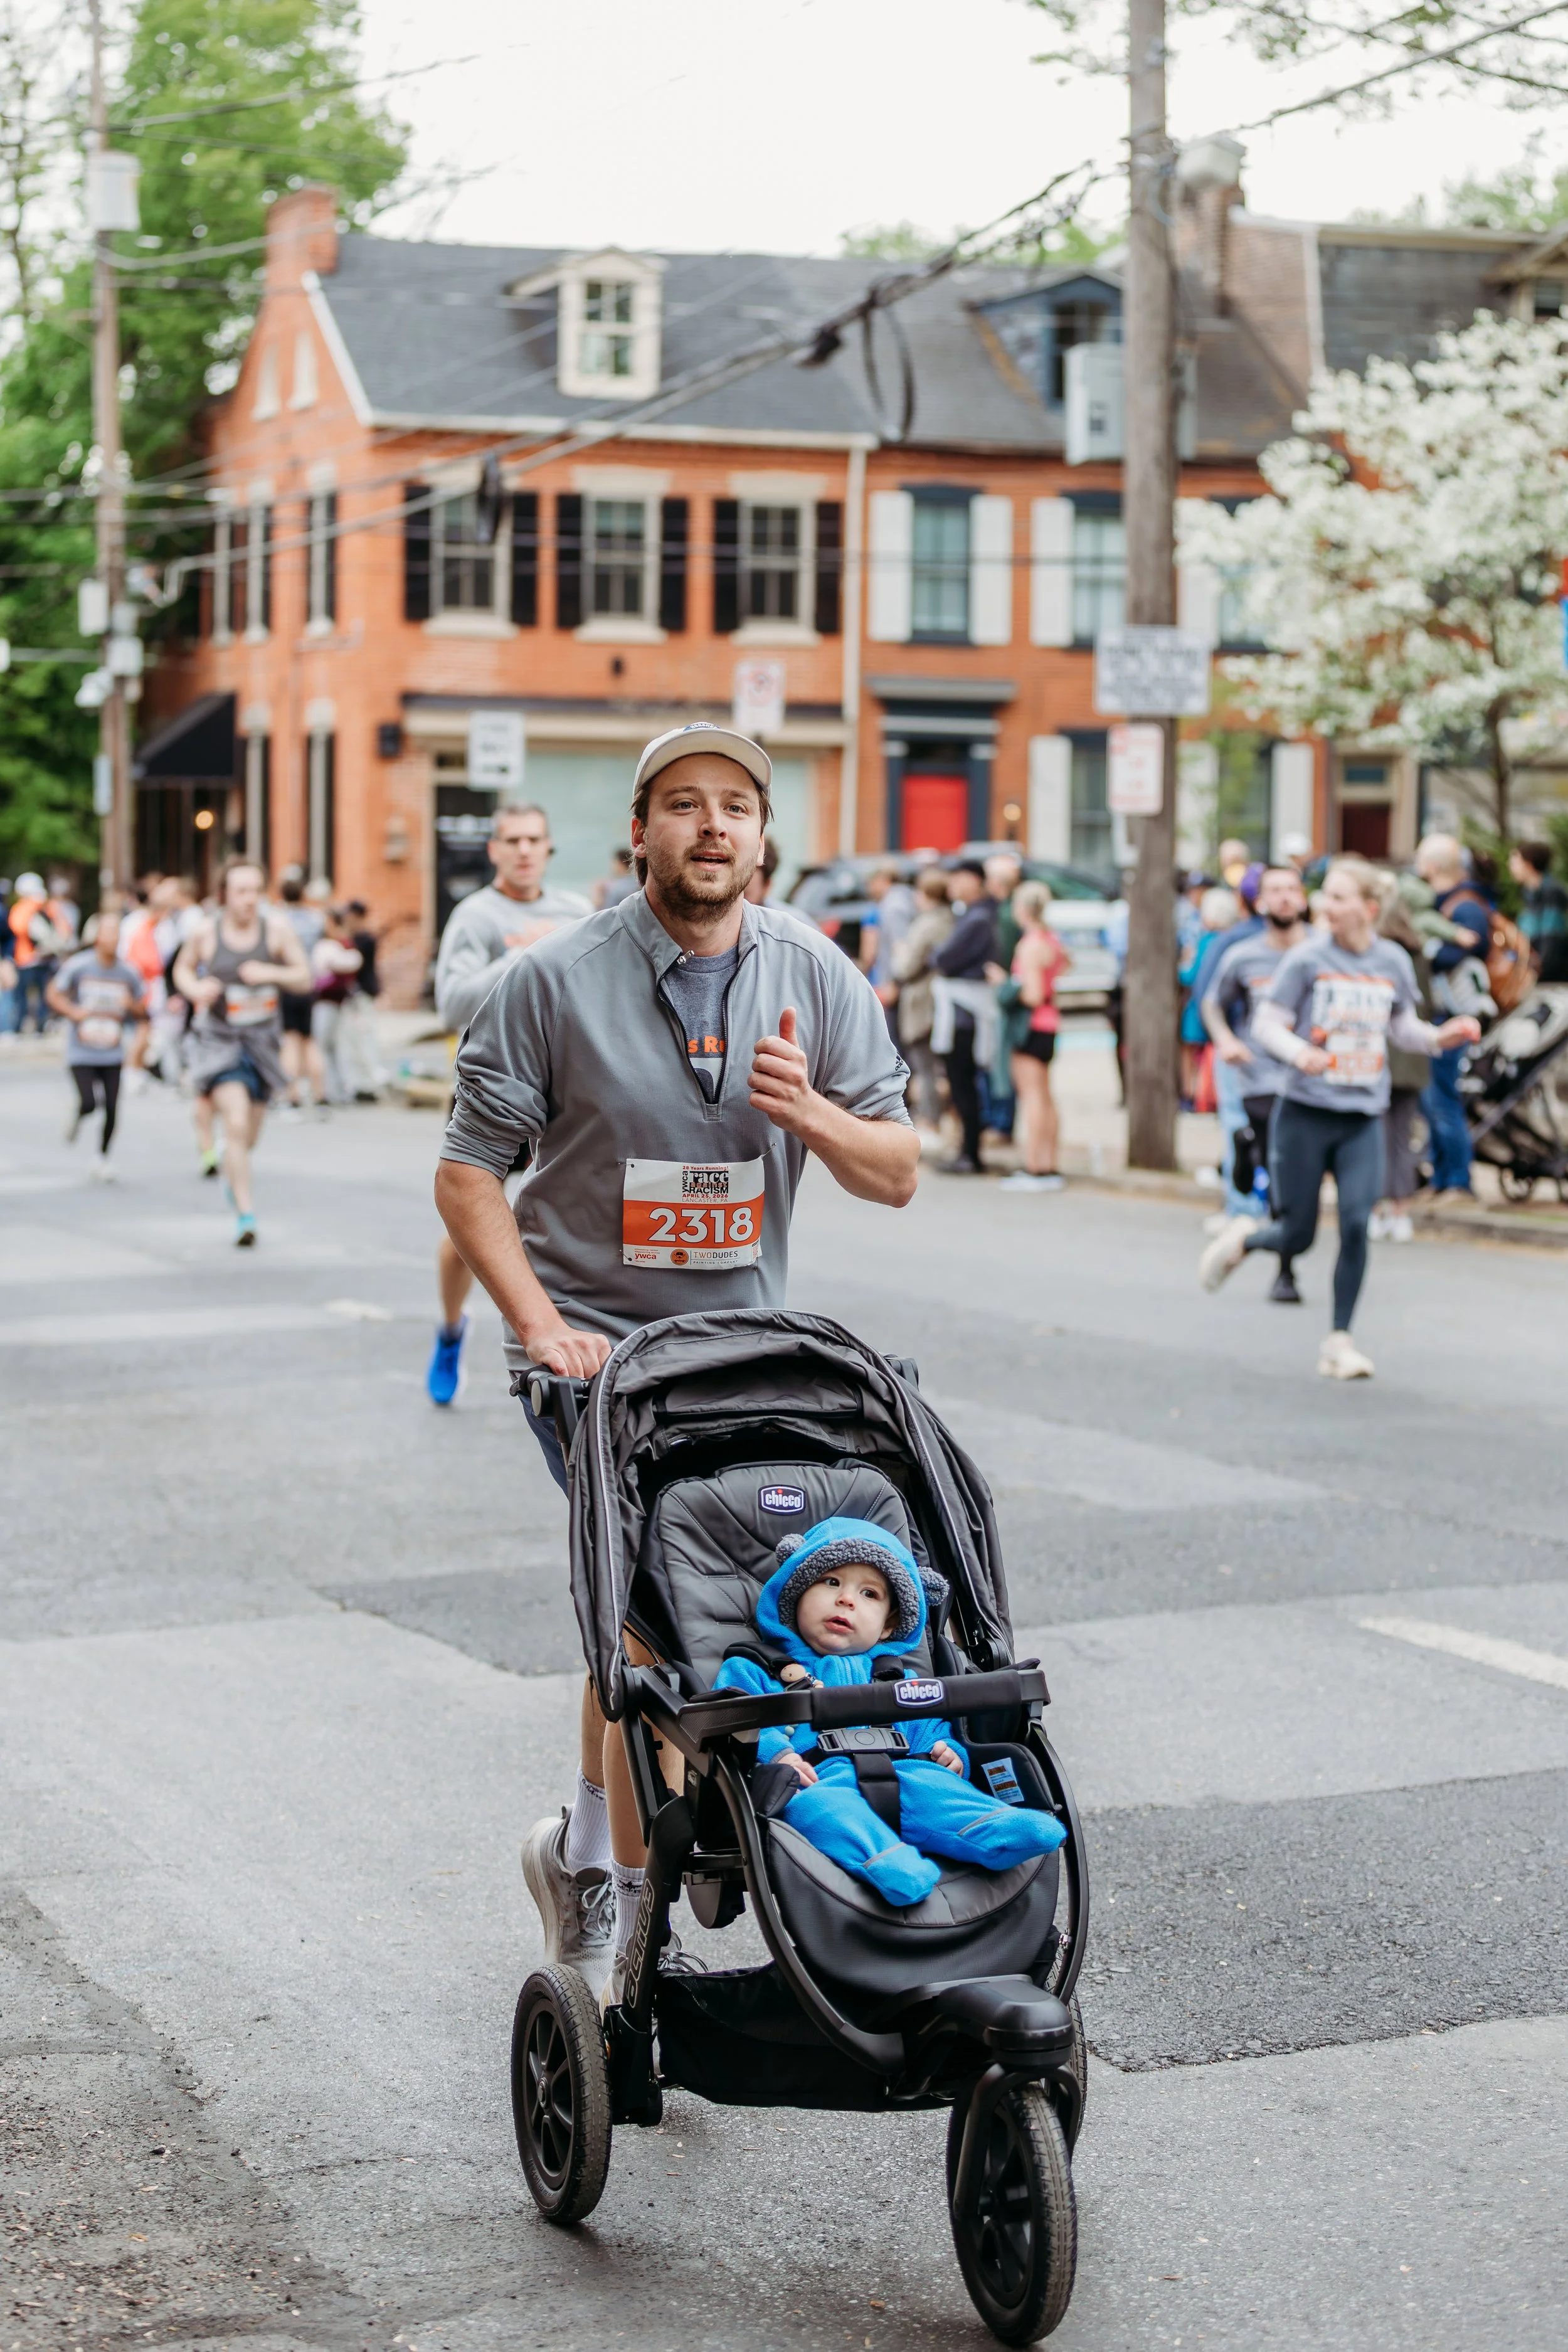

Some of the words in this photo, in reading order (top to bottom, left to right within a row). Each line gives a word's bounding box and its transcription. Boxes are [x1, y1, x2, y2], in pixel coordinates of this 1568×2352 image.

[690, 1172, 729, 1183] race
[647, 1207, 753, 1243] 2318
[765, 1488, 802, 1508] chicco
[899, 1681, 940, 1700] chicco
